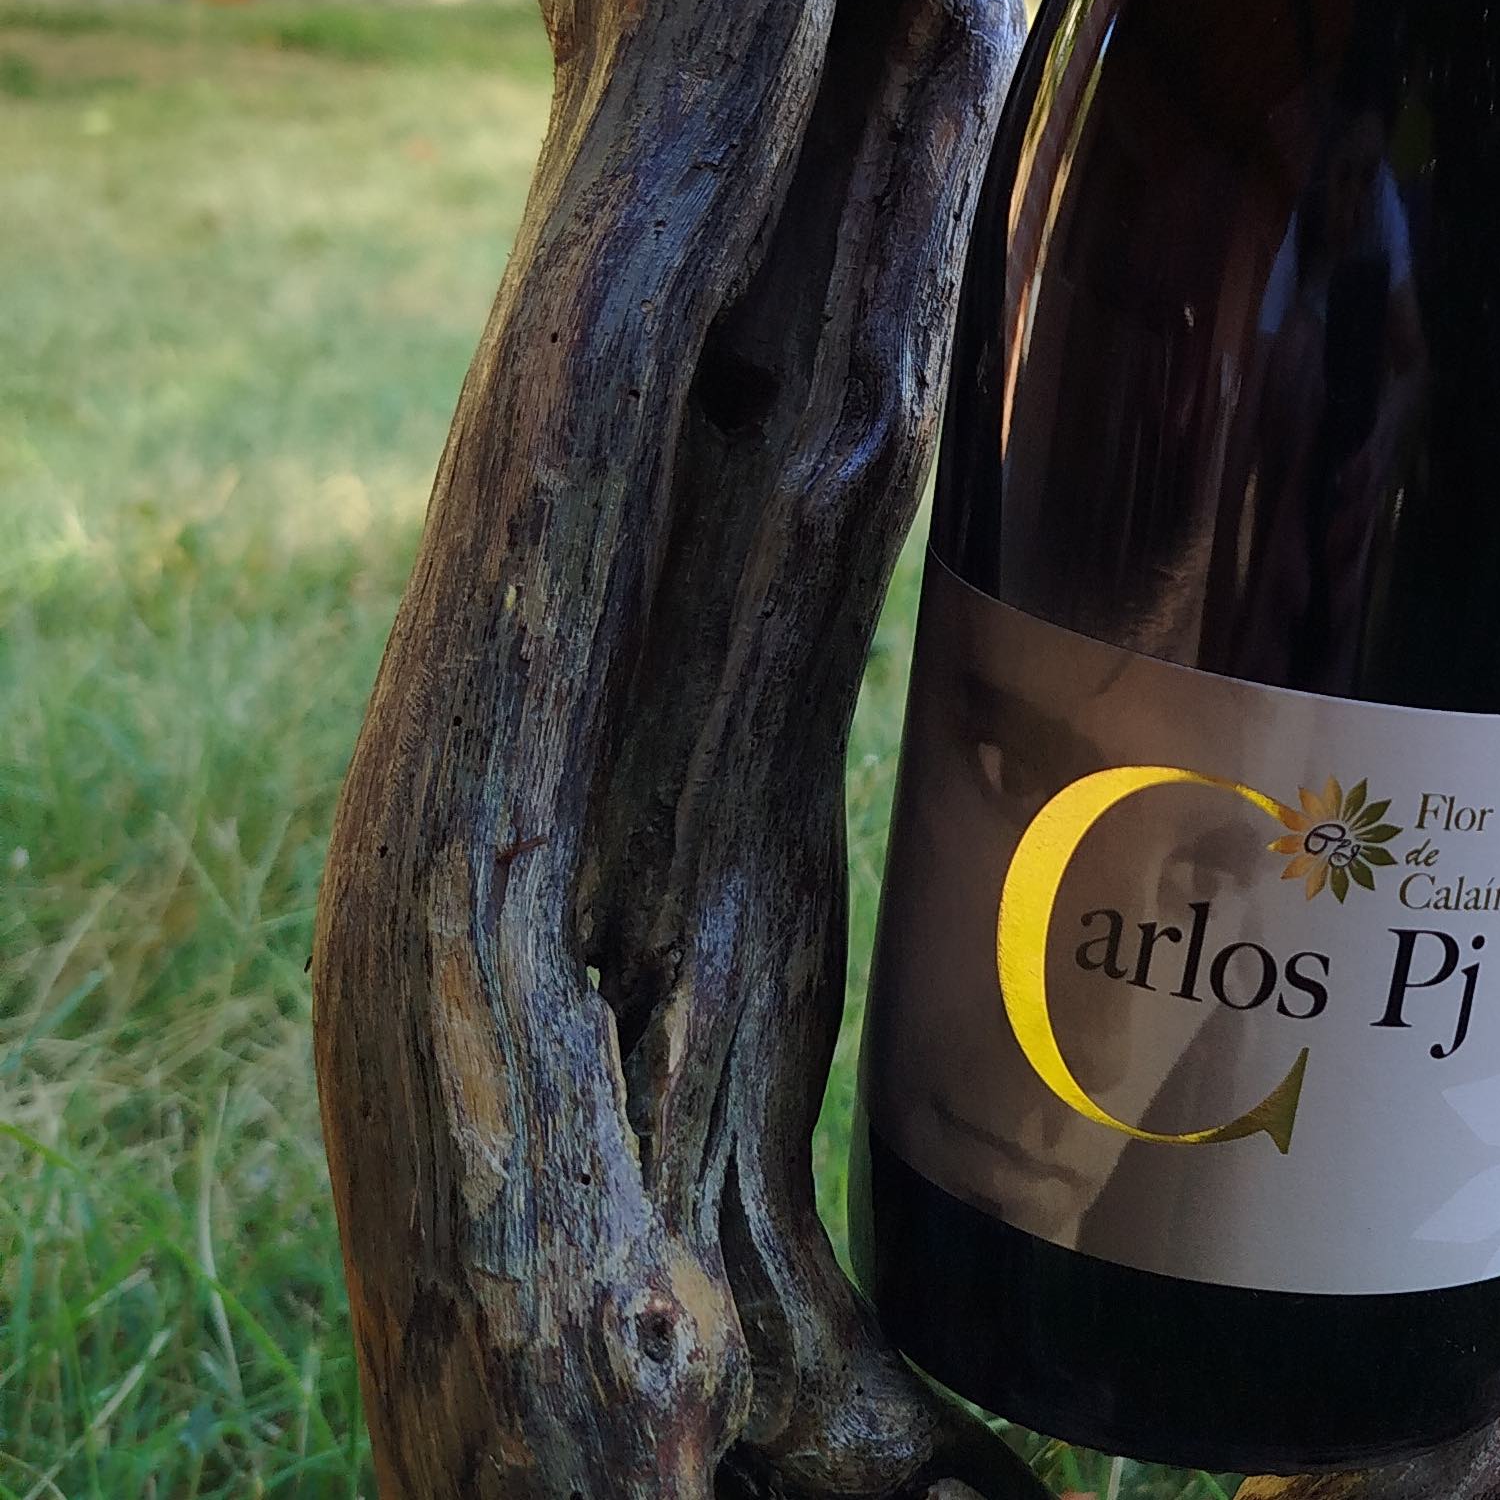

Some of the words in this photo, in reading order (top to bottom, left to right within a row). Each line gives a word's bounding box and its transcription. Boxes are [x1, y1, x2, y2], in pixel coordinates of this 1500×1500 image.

[1414, 792, 1495, 834] Flor
[1404, 840, 1438, 868] de
[1369, 928, 1486, 1061] Pj
